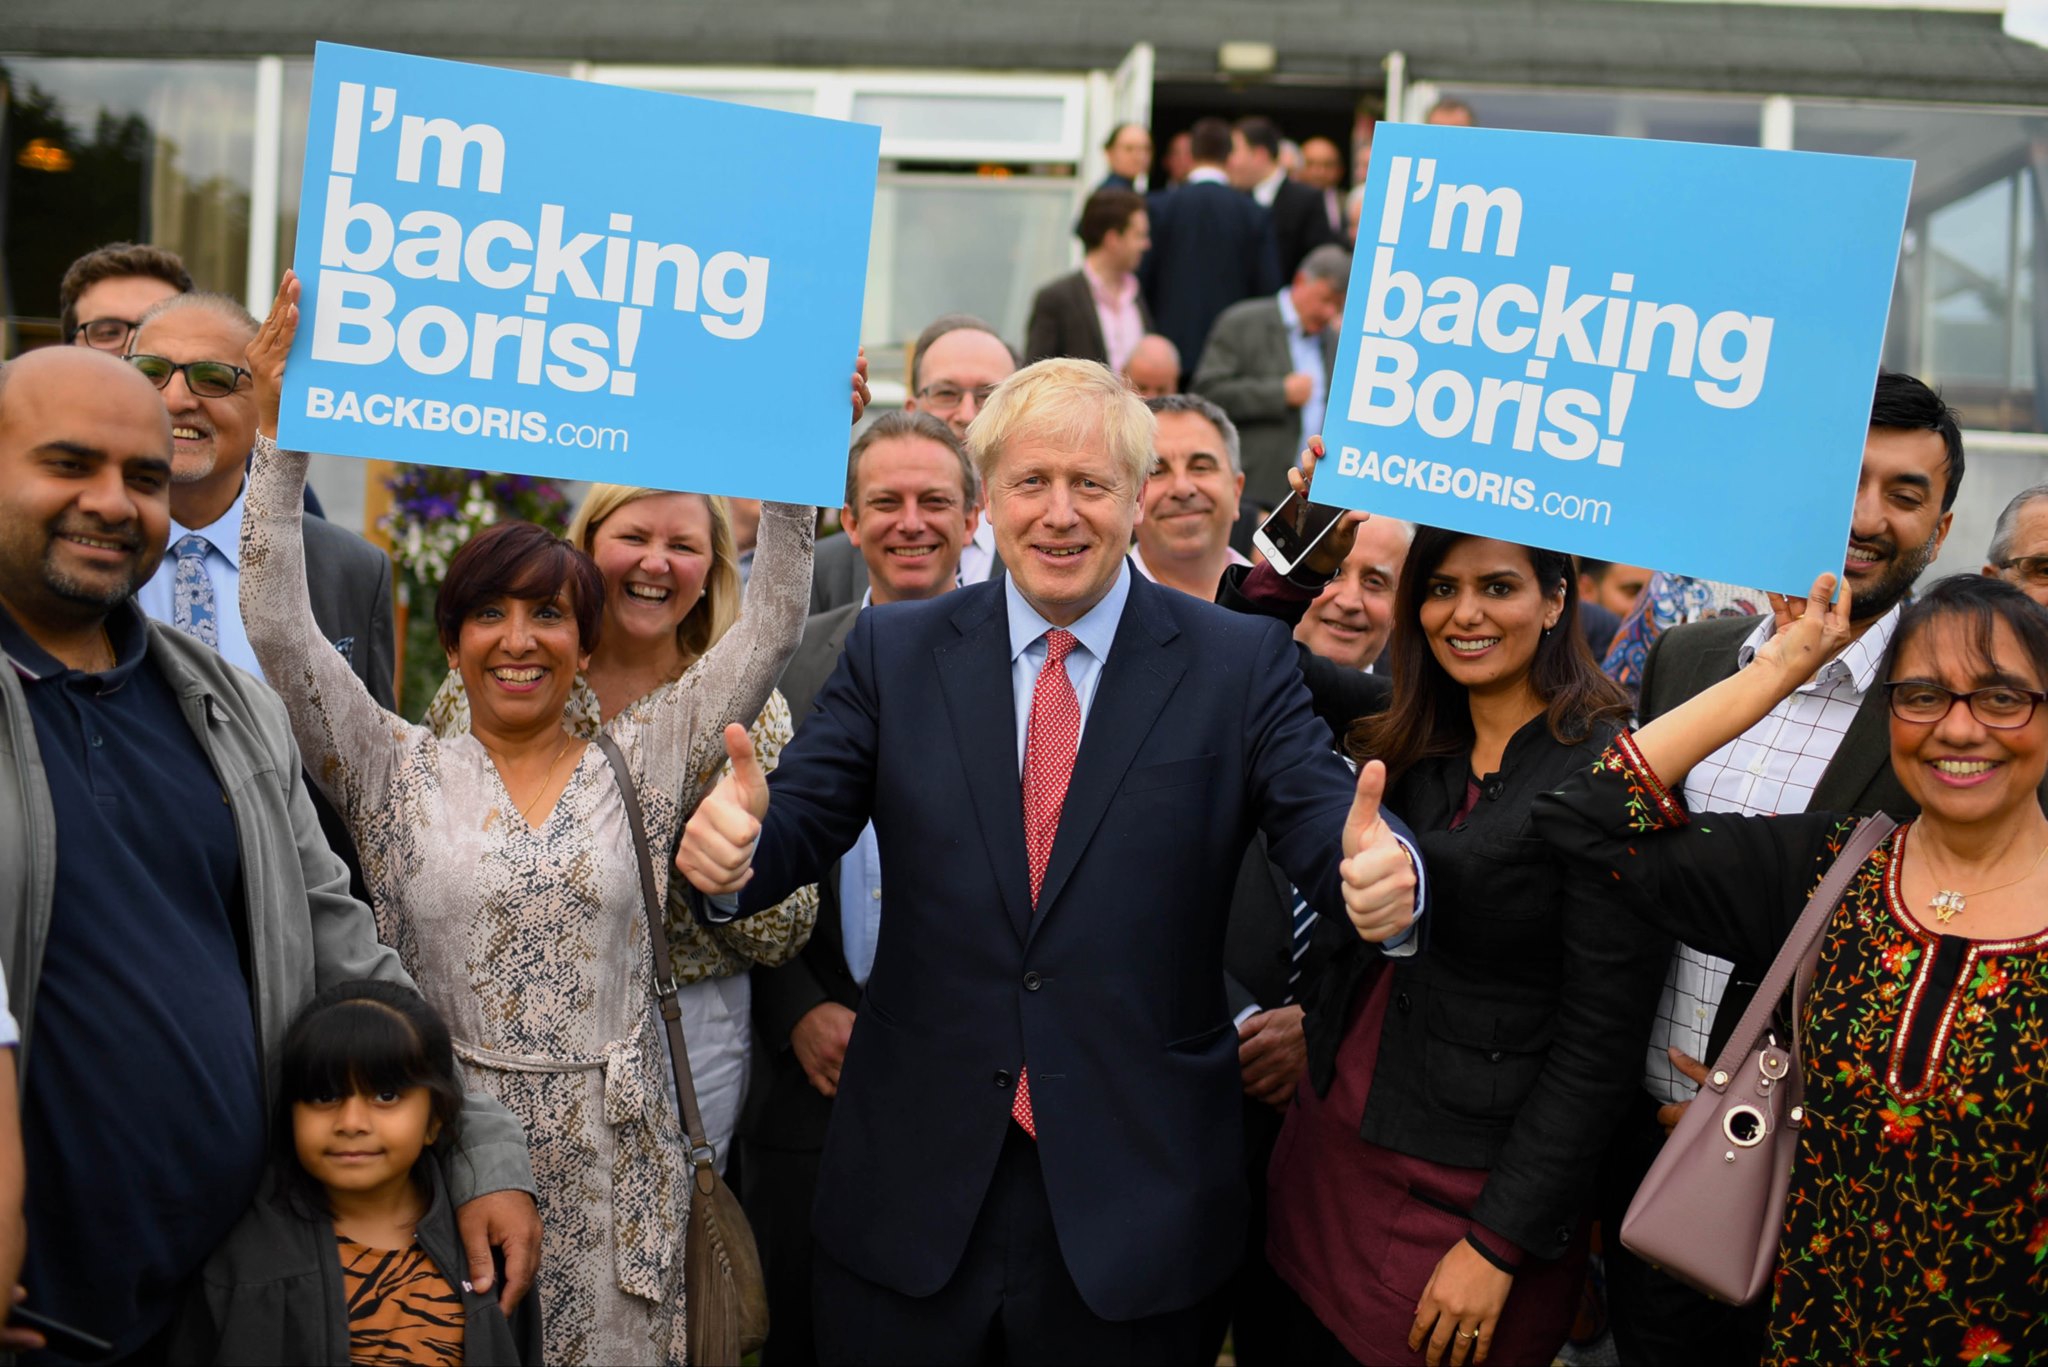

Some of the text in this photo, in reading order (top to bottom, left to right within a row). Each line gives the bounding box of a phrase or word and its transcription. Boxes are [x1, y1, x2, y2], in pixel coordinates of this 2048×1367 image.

[320, 176, 769, 339] backing
[312, 269, 642, 396] Boris!
[1363, 246, 1774, 408] backing
[306, 387, 628, 451] BACKBORIS.com
[1348, 336, 1635, 467] Boris!
[1338, 447, 1611, 526] BACKBORIS.com
